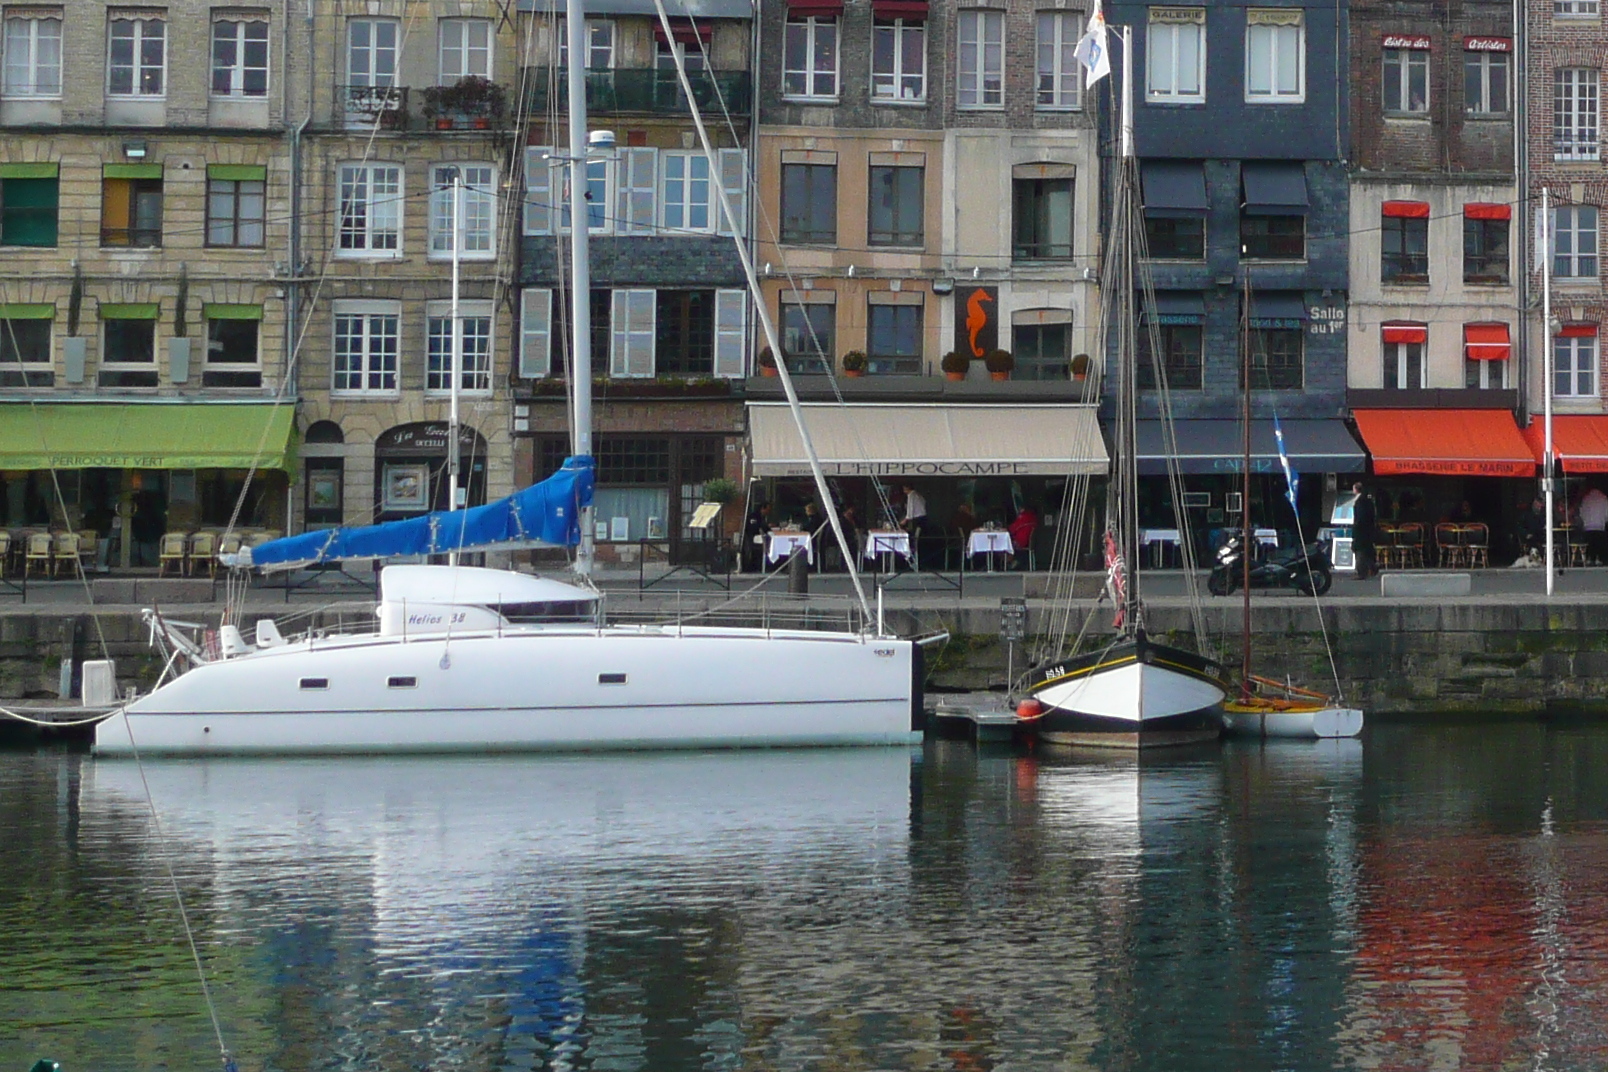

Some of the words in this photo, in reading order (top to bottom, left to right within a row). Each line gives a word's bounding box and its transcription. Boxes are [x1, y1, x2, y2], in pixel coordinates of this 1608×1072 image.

[1152, 11, 1203, 20] GALERIE
[1468, 38, 1507, 50] Artistes
[1310, 323, 1326, 334] au
[51, 455, 129, 467] PERROQUET
[133, 456, 164, 466] VERT
[837, 461, 1029, 476] L'HIPPOCAMPE
[1395, 461, 1456, 473] BRASSERIE
[1461, 464, 1475, 473] LE
[1479, 463, 1515, 474] MARIN
[409, 614, 442, 625] Helios
[451, 612, 466, 624] 38
